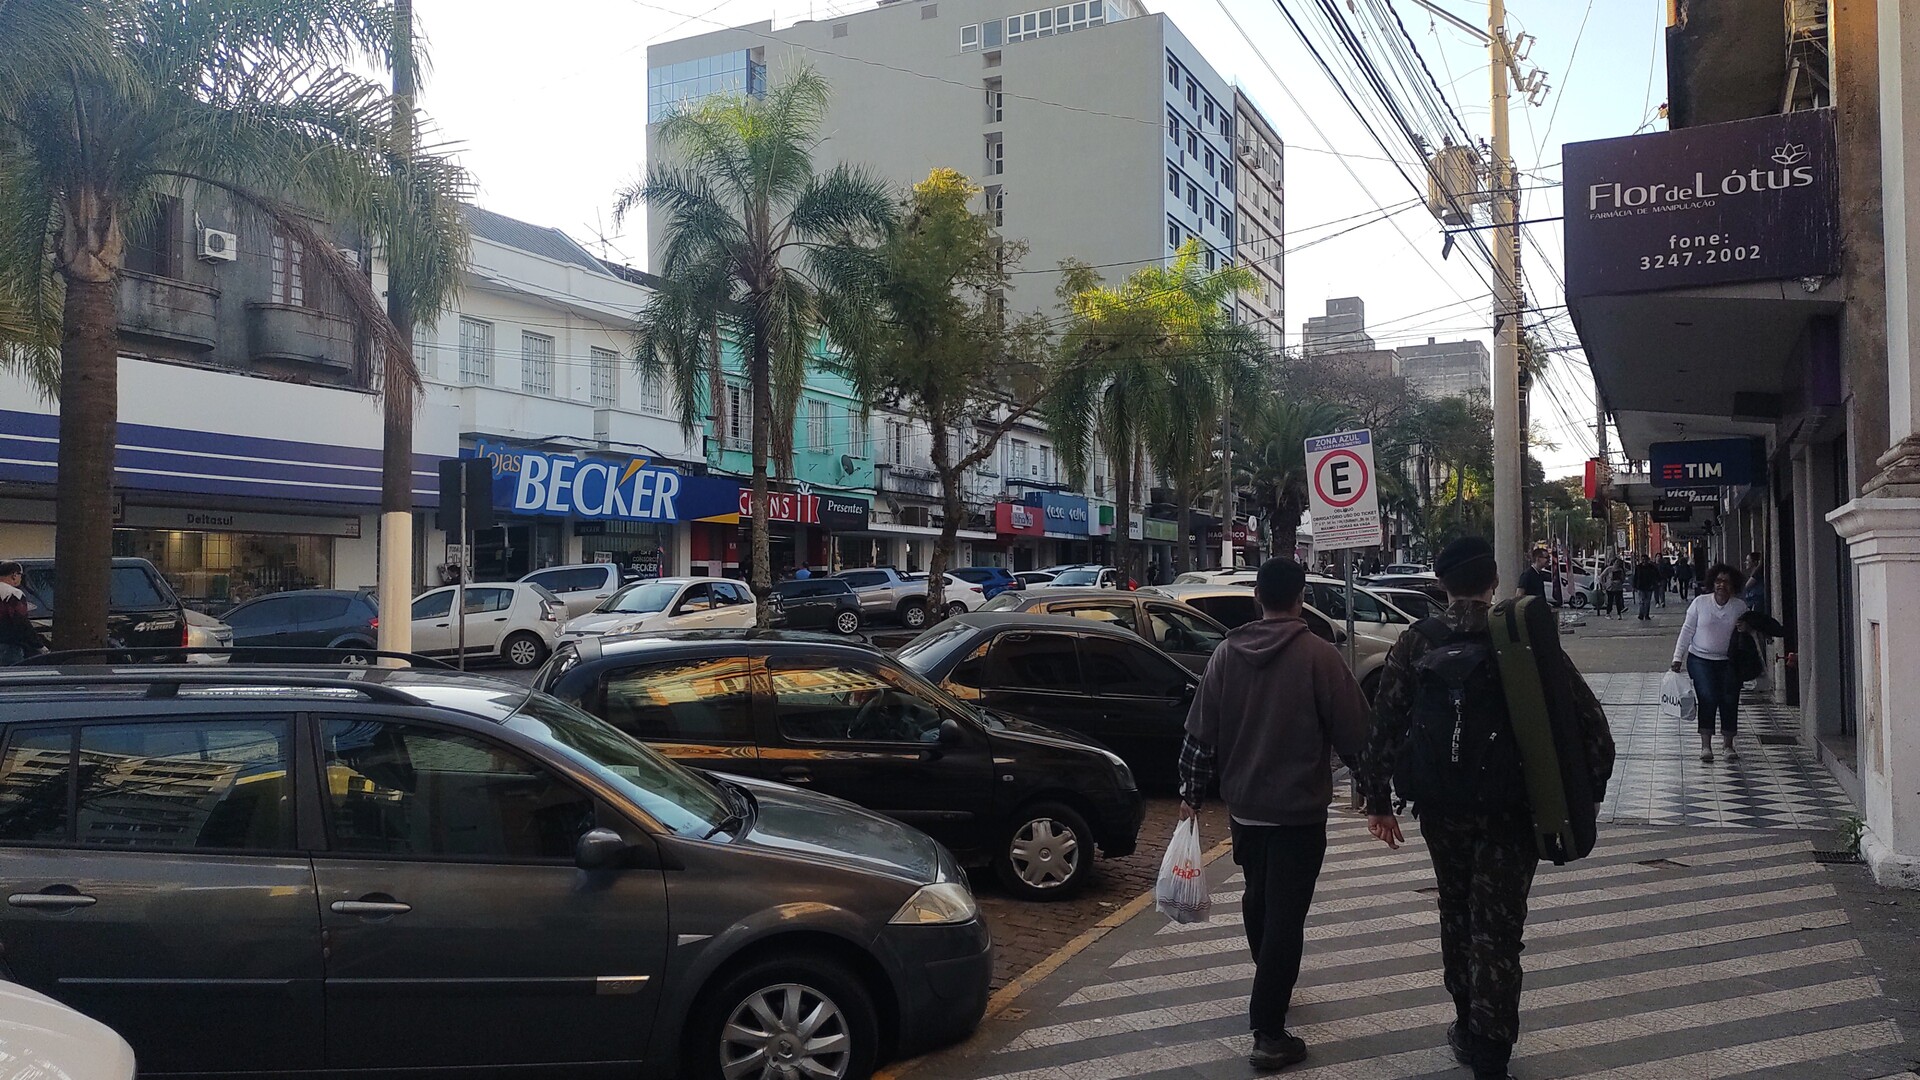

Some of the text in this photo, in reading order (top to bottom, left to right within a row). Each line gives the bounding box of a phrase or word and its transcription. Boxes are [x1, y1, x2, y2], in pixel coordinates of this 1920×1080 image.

[1589, 165, 1814, 210] Flor de Lótus
[1589, 199, 1716, 220] FARMÁCIA DE MANIPULAÇÃO
[1669, 231, 1730, 249] fone:
[1640, 245, 1761, 270] 3247.2002
[1315, 433, 1360, 447] ZONA AZUL
[477, 444, 521, 476] Lojas
[1330, 461, 1352, 496] E
[1685, 462, 1722, 478] TIM
[515, 454, 680, 520] BECKER
[827, 499, 863, 515] Presentes
[187, 513, 234, 526] Deltasul
[1207, 531, 1246, 539] MAGICO
